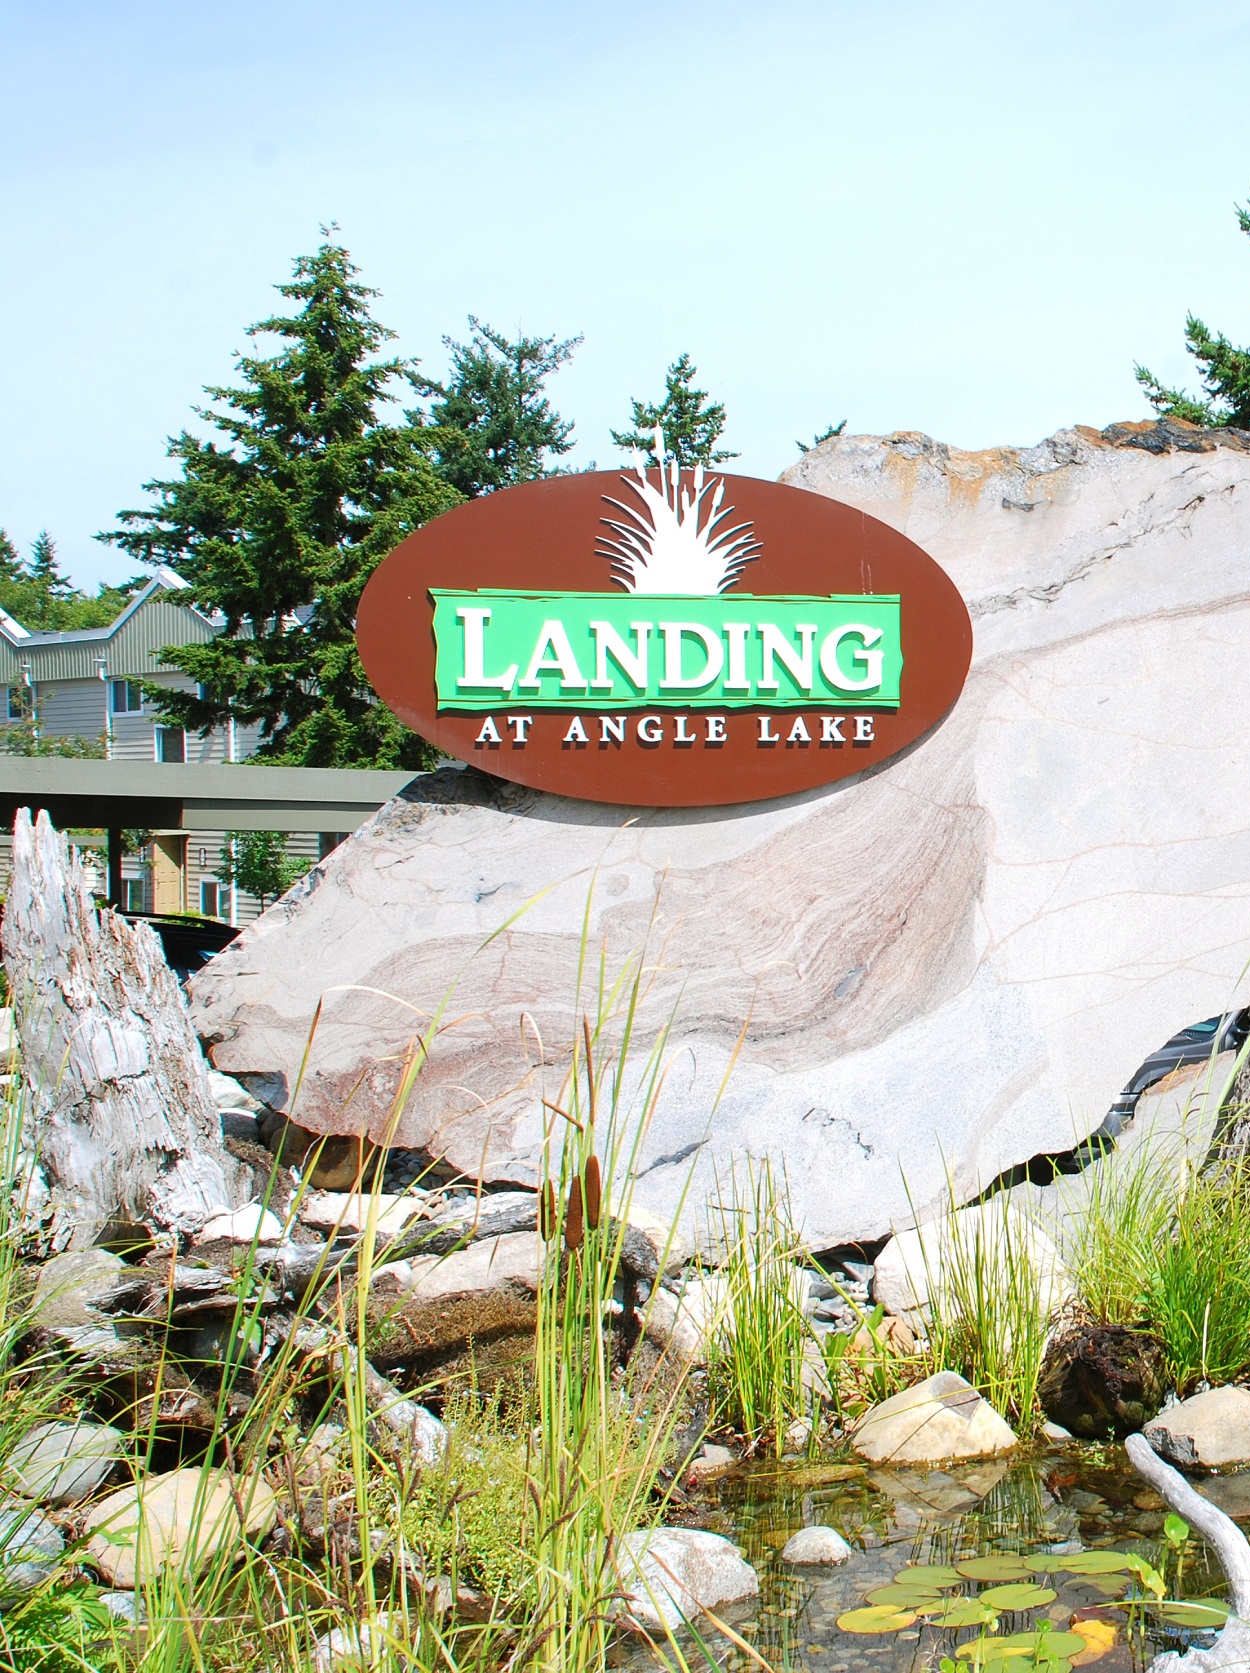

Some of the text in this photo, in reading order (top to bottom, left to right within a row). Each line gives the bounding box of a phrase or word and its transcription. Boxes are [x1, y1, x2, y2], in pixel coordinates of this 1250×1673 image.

[455, 607, 885, 693] LANDING
[474, 715, 877, 744] AT ANGLE LAKE
